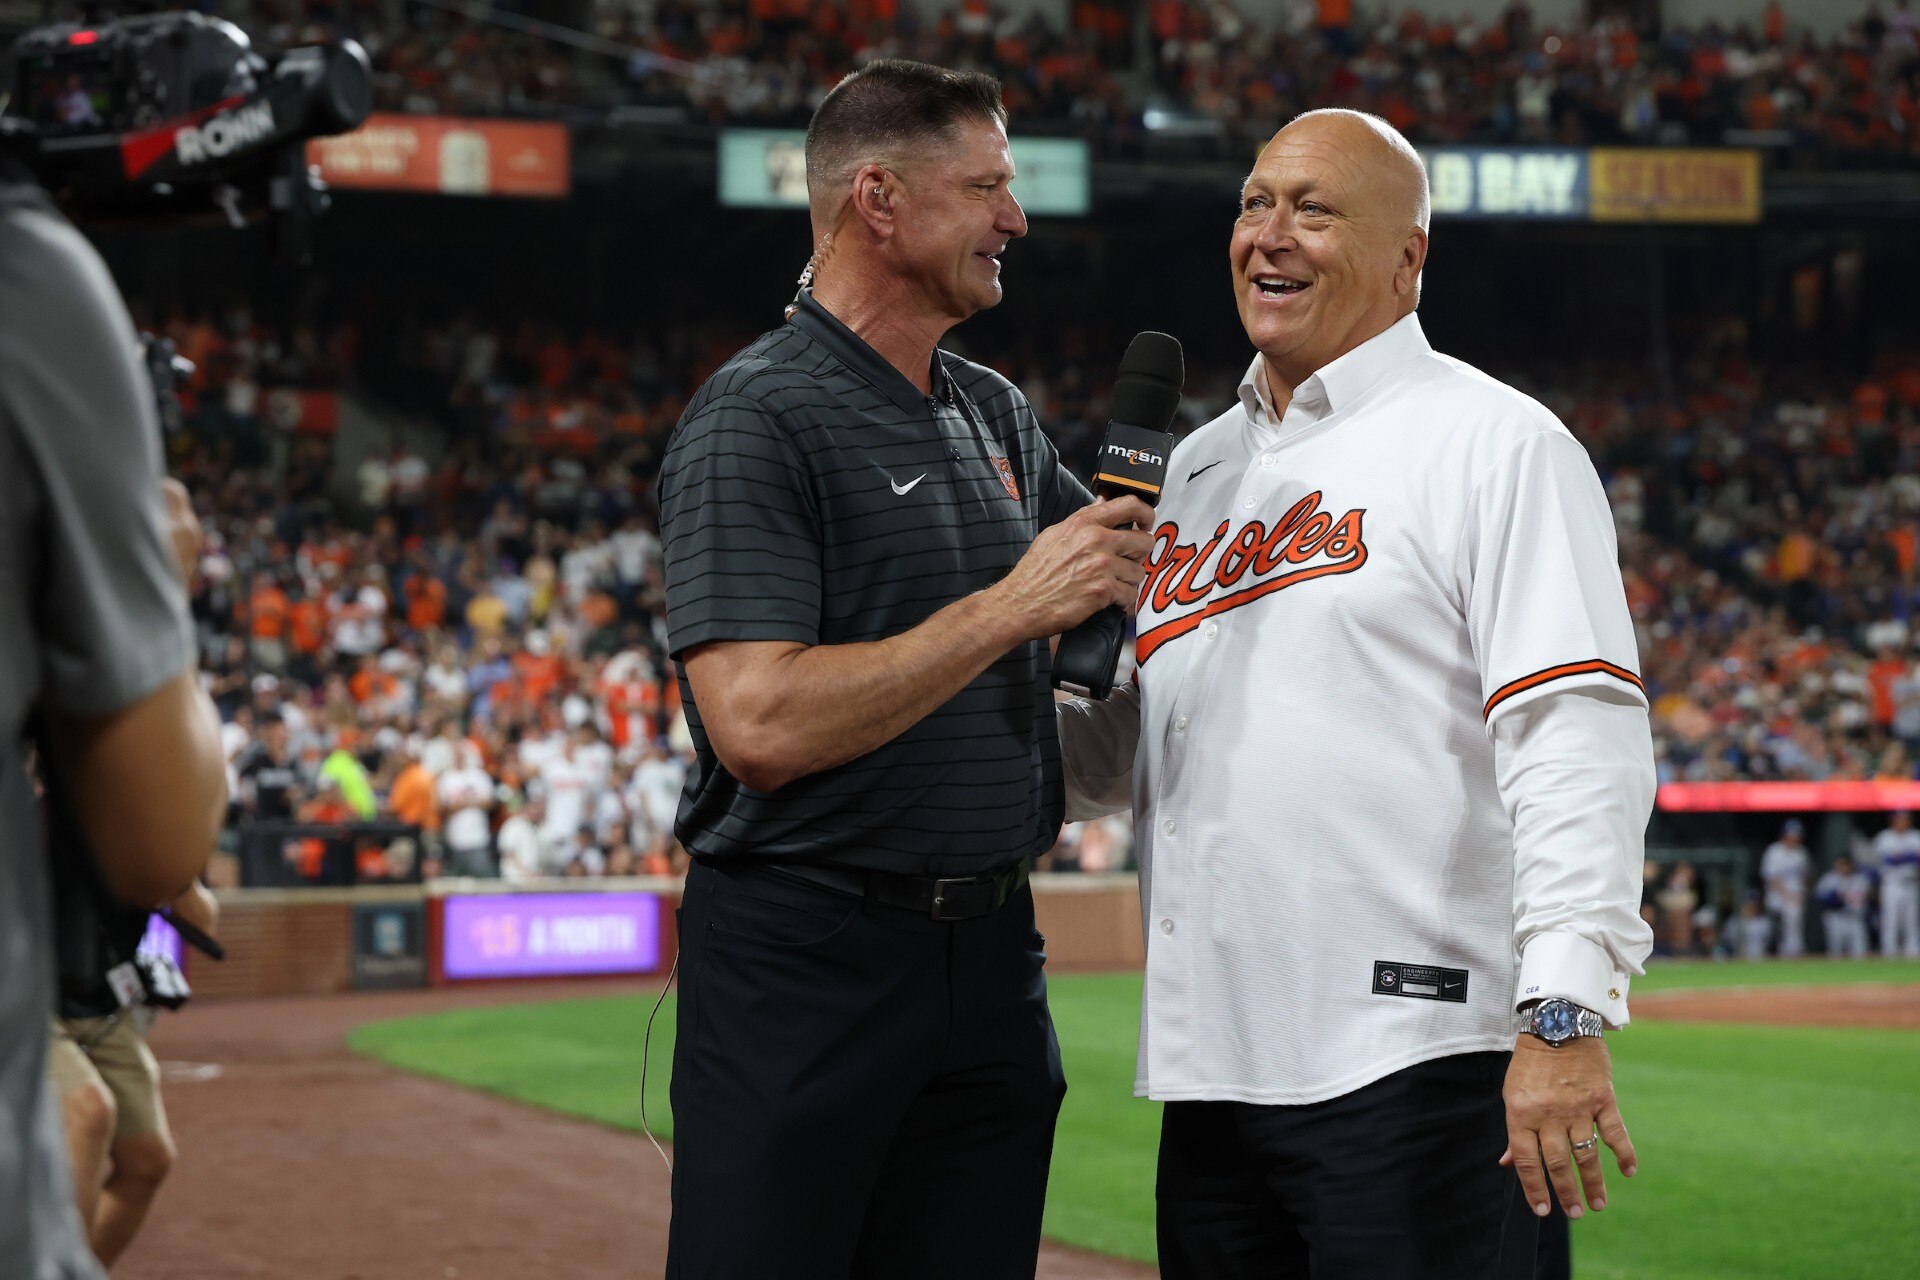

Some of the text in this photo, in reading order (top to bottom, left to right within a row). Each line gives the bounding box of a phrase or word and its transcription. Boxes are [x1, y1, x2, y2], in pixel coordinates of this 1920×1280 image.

[1478, 152, 1579, 213] BAY
[1107, 444, 1163, 466] masn
[1525, 985, 1540, 994] CER
